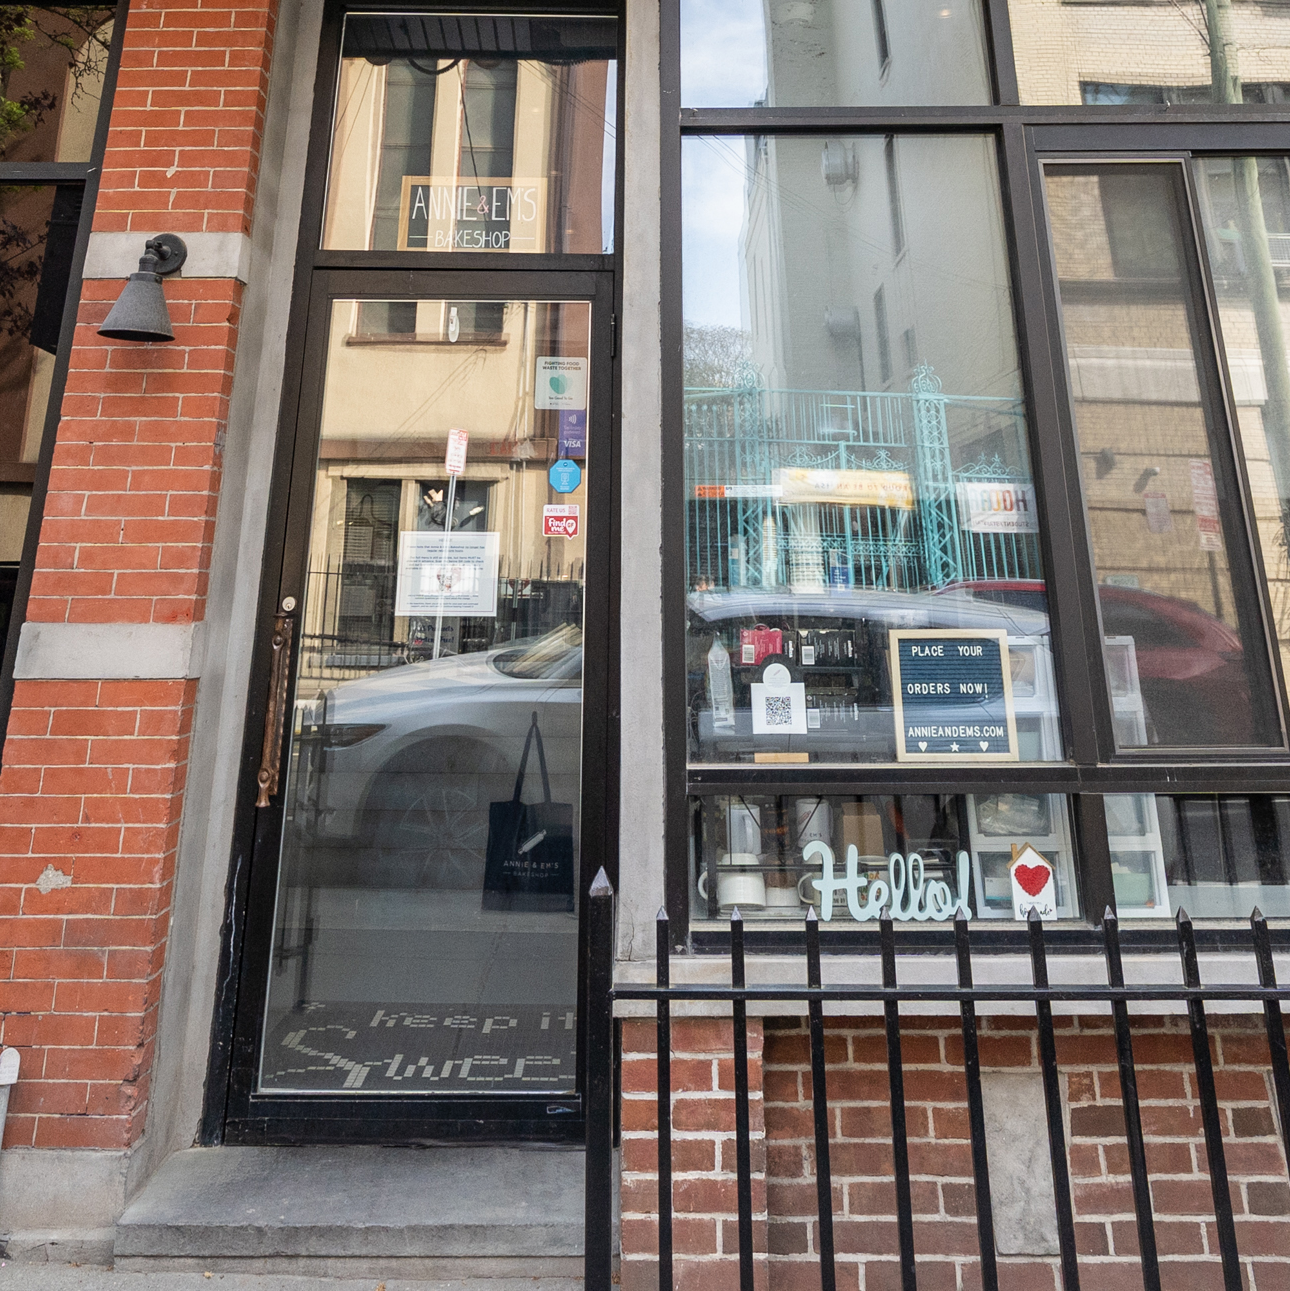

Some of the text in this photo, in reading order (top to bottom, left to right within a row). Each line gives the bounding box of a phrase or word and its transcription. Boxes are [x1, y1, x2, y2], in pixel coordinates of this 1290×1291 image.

[412, 186, 537, 222] ANNIE & EM'S
[434, 230, 511, 248] BAKESHOP
[563, 440, 581, 448] VISA
[911, 645, 983, 656] PLACE YOUR
[907, 683, 988, 699] ORDERS NOW!
[908, 725, 1004, 737] ANNIEANDEMS.COM
[503, 860, 529, 868] ANNIE
[802, 840, 972, 921] Hello!
[264, 1025, 577, 1088] Swee
